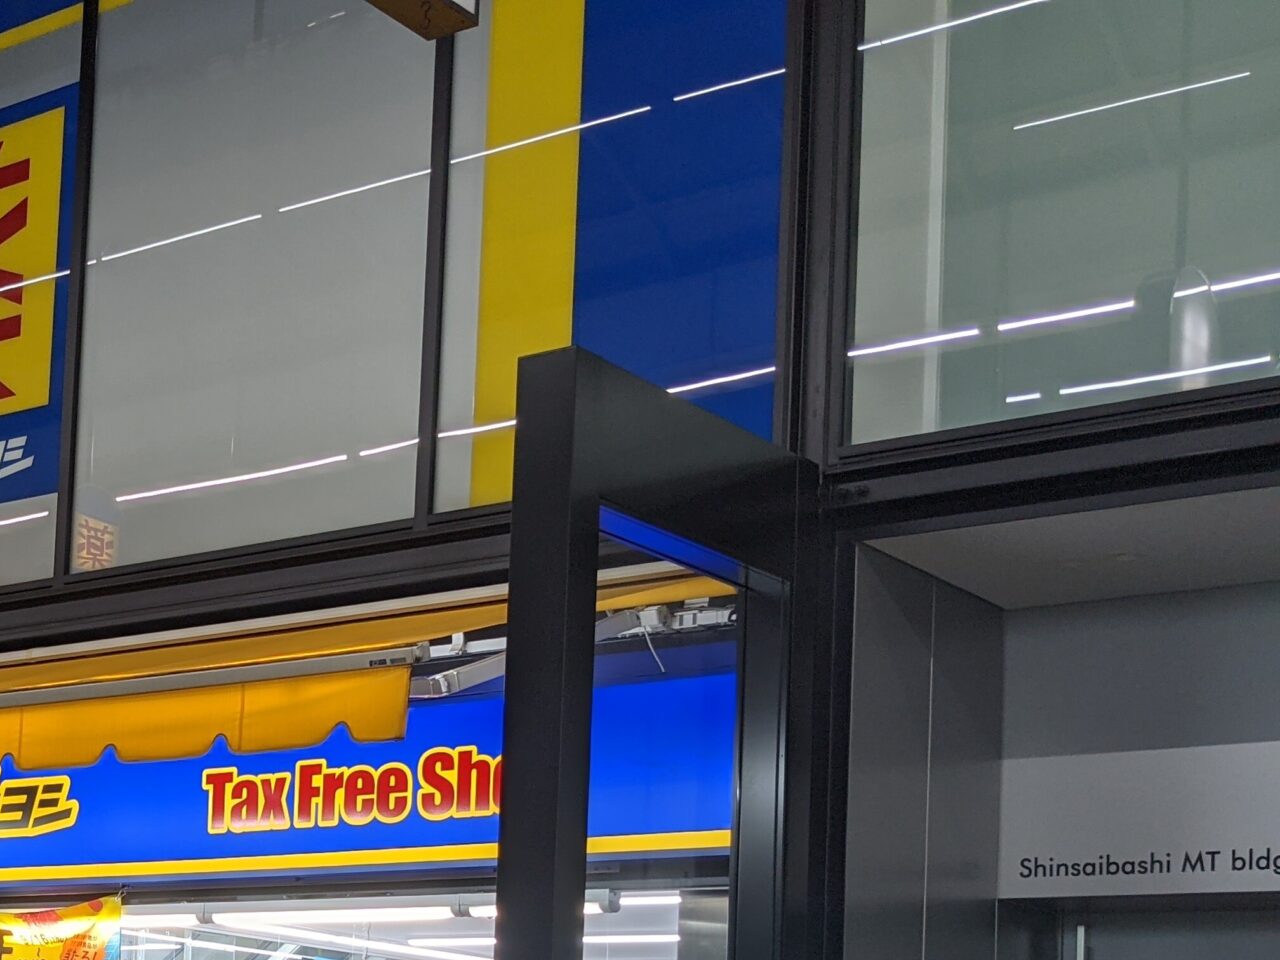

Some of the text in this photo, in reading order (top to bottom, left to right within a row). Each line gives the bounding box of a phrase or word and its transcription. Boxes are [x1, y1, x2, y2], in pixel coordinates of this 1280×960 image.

[203, 767, 290, 834] Tax
[293, 758, 413, 829] Free
[1018, 852, 1172, 879] Shinsaibashi
[1181, 850, 1221, 873] MT
